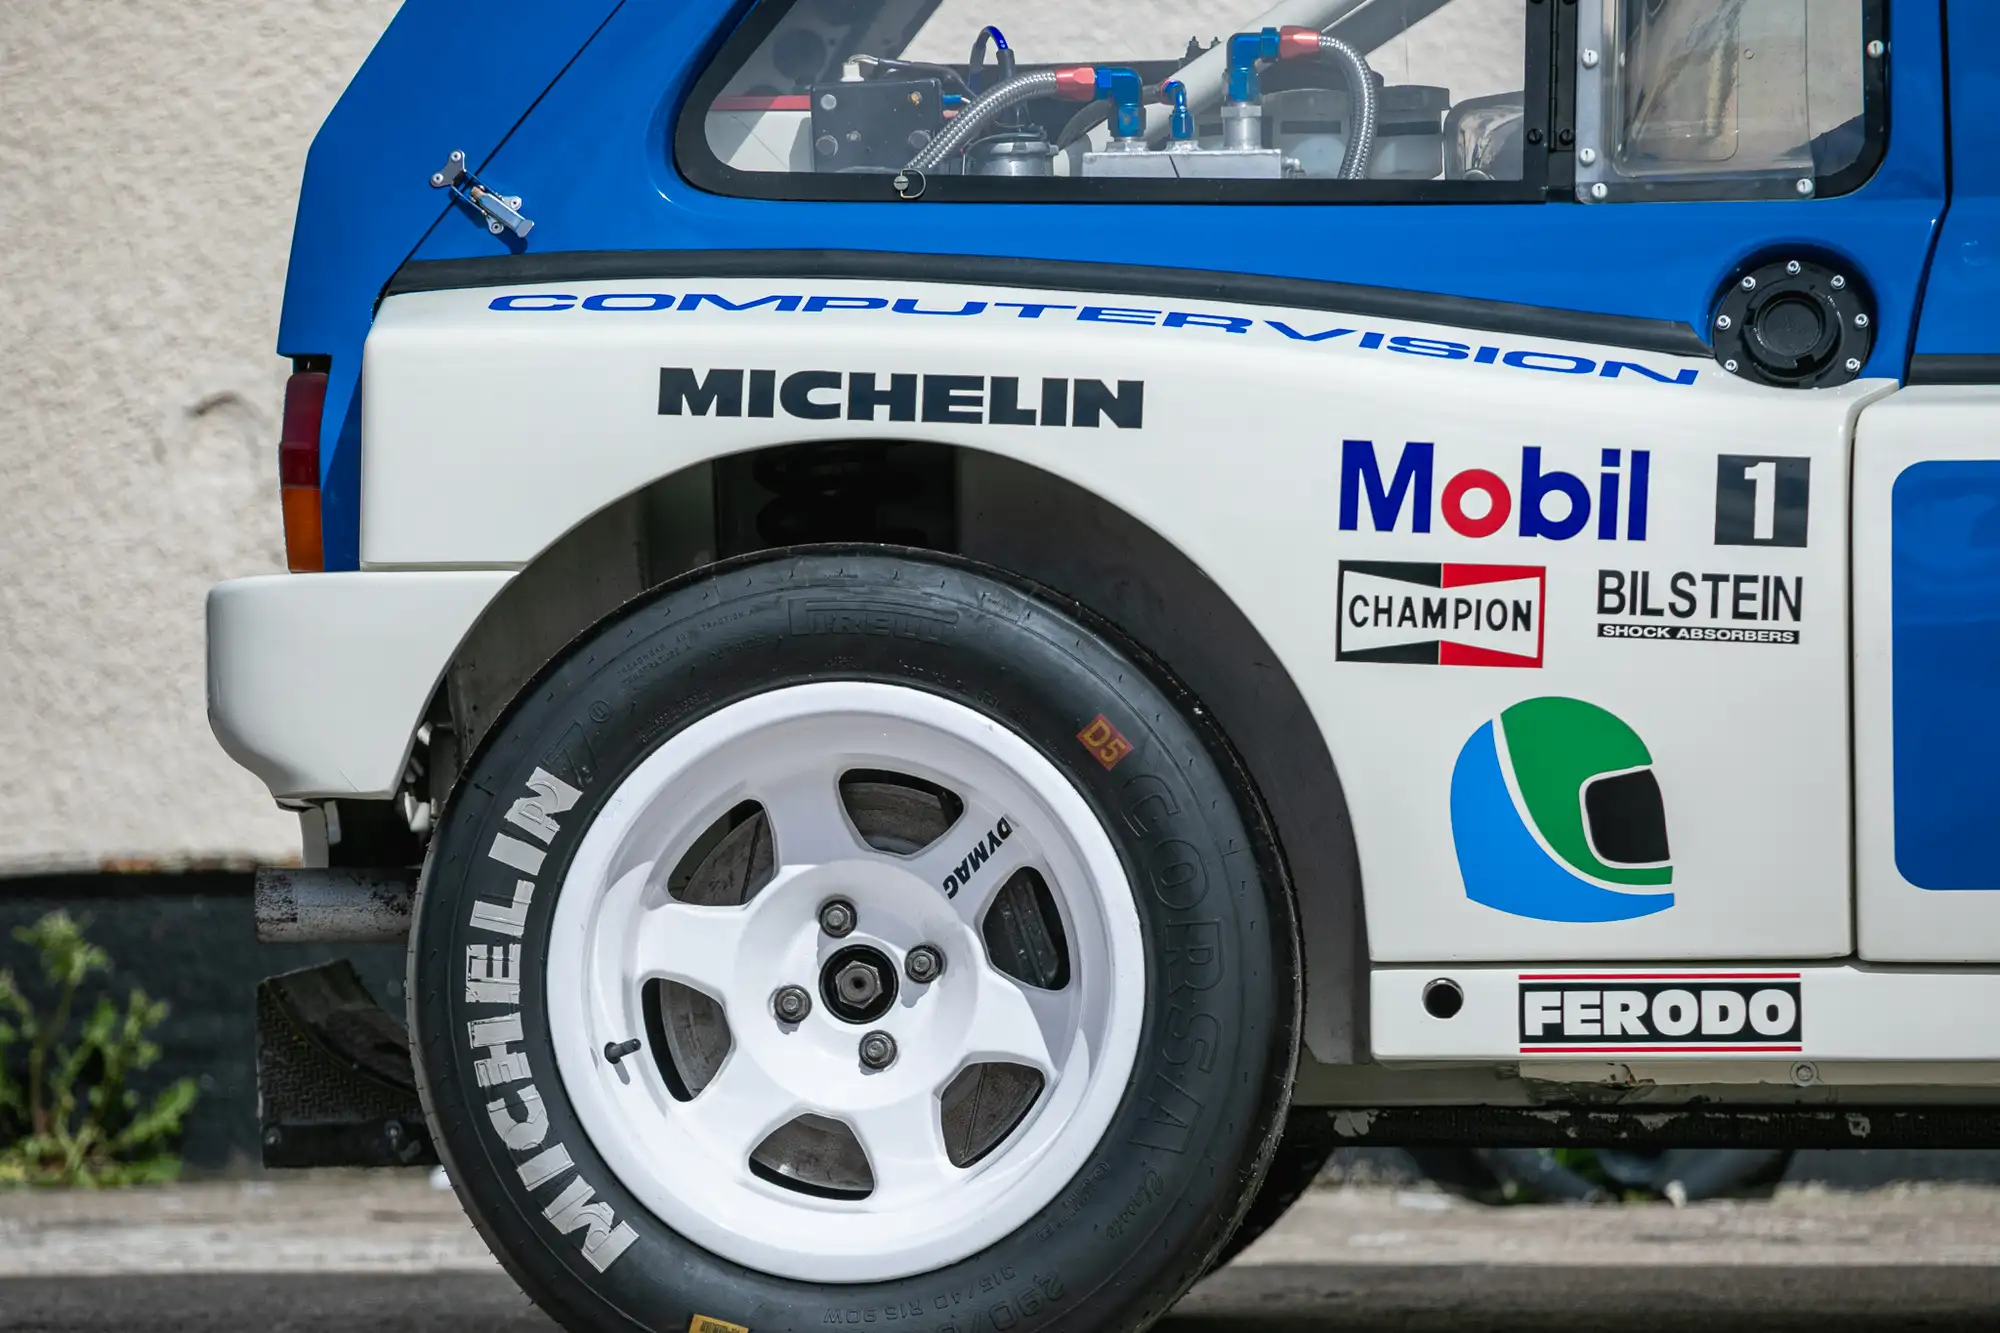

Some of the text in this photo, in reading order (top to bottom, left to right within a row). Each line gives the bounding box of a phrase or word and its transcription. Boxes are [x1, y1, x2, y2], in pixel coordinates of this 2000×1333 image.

[488, 294, 1699, 386] COMPUTERVISION
[657, 367, 1144, 428] MICHELIN
[1338, 439, 1778, 541] Mobil 1
[1348, 594, 1532, 632] CHAMPION
[1597, 569, 1803, 622] BILSTEIN
[1603, 625, 1795, 643] SHOCK ABSORBERS
[1081, 719, 1126, 763] D5
[942, 816, 1013, 899] DYMAG
[1121, 774, 1224, 1155] CORSA
[465, 766, 640, 1273] MICHELIN
[1524, 989, 1797, 1036] FERODO
